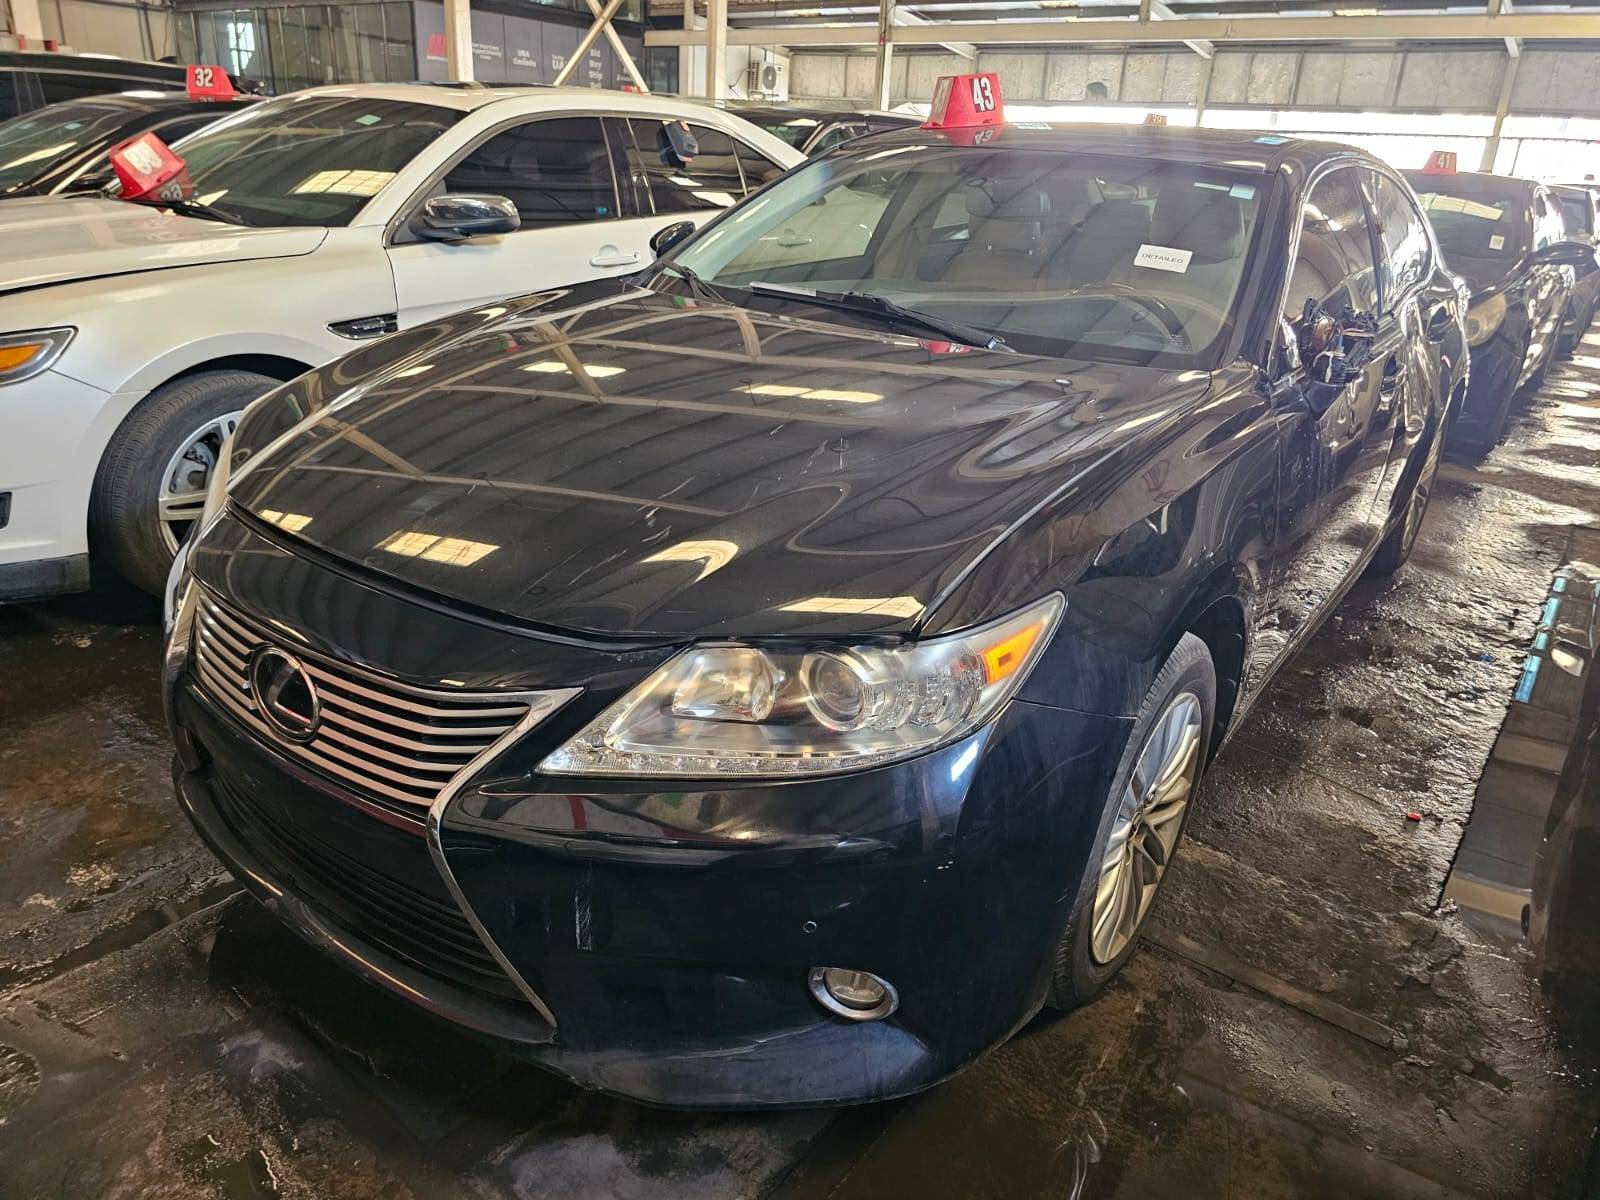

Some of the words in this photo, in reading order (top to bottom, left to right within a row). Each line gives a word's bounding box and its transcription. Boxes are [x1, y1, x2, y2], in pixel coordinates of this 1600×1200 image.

[194, 67, 214, 88] 32
[973, 77, 996, 111] 43
[1437, 153, 1450, 169] 41
[1141, 252, 1185, 264] DETAILED
